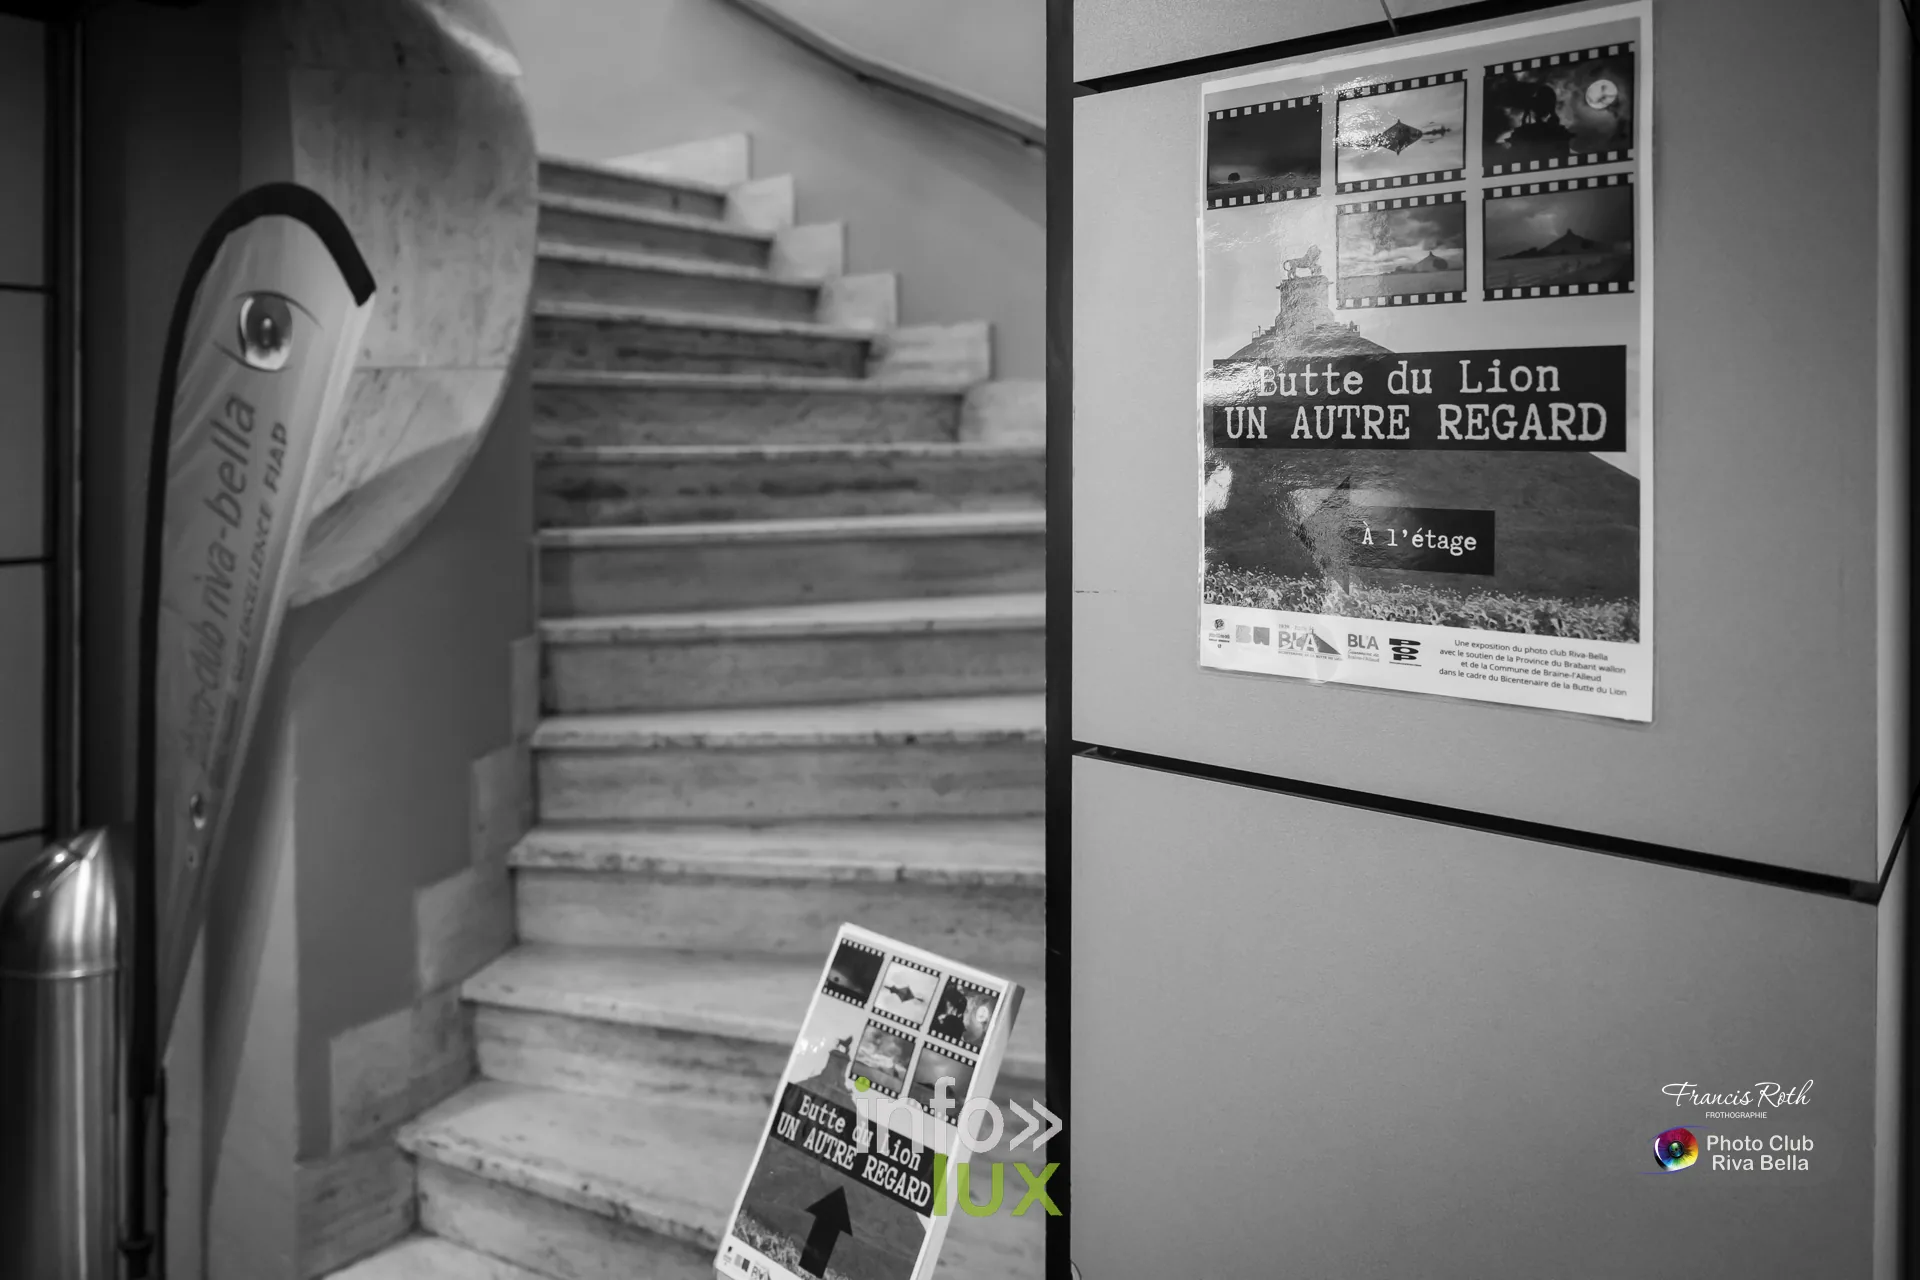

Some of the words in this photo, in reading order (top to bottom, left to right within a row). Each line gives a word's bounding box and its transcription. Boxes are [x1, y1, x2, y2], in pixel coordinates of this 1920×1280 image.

[1258, 362, 1364, 398] Butte
[1387, 360, 1432, 395] du
[1458, 359, 1561, 394] Lion
[1224, 405, 1268, 440] UN
[1290, 404, 1410, 441] AUTRE
[1437, 402, 1608, 441] REGARD
[1361, 520, 1375, 546] À
[1386, 526, 1478, 557] l'étage
[1439, 649, 1456, 657] avec
[1457, 649, 1465, 657] le
[1465, 651, 1494, 660] soutien
[1495, 654, 1505, 662] de
[1506, 655, 1514, 663] la
[1515, 655, 1550, 666] Province
[1551, 659, 1562, 668] du
[1564, 660, 1597, 671] Brabant
[1598, 665, 1626, 674] wallon
[1454, 640, 1470, 648] Une
[1471, 641, 1511, 652] exposition
[1512, 645, 1523, 653] du
[1524, 645, 1548, 655] photo
[1549, 648, 1567, 657] club
[1568, 650, 1609, 661] Riva-Bella
[1469, 661, 1479, 669] de
[1480, 662, 1488, 670] la
[1489, 663, 1530, 675] Commune
[1531, 668, 1541, 676] de
[1438, 668, 1457, 677] dans
[1457, 670, 1465, 678] le
[1466, 672, 1487, 680] cadre
[1488, 674, 1499, 682] du
[1500, 675, 1549, 688] Bicentenaire
[1563, 682, 1571, 690] la
[1572, 683, 1595, 692] Butte
[1596, 686, 1608, 694] du
[1609, 687, 1627, 696] Lion
[797, 1094, 846, 1134] Butte
[851, 1120, 874, 1148] du
[879, 1132, 922, 1171] Lion
[776, 1111, 801, 1142] UN
[803, 1127, 858, 1171] AUTRE
[861, 1155, 931, 1208] REGARD
